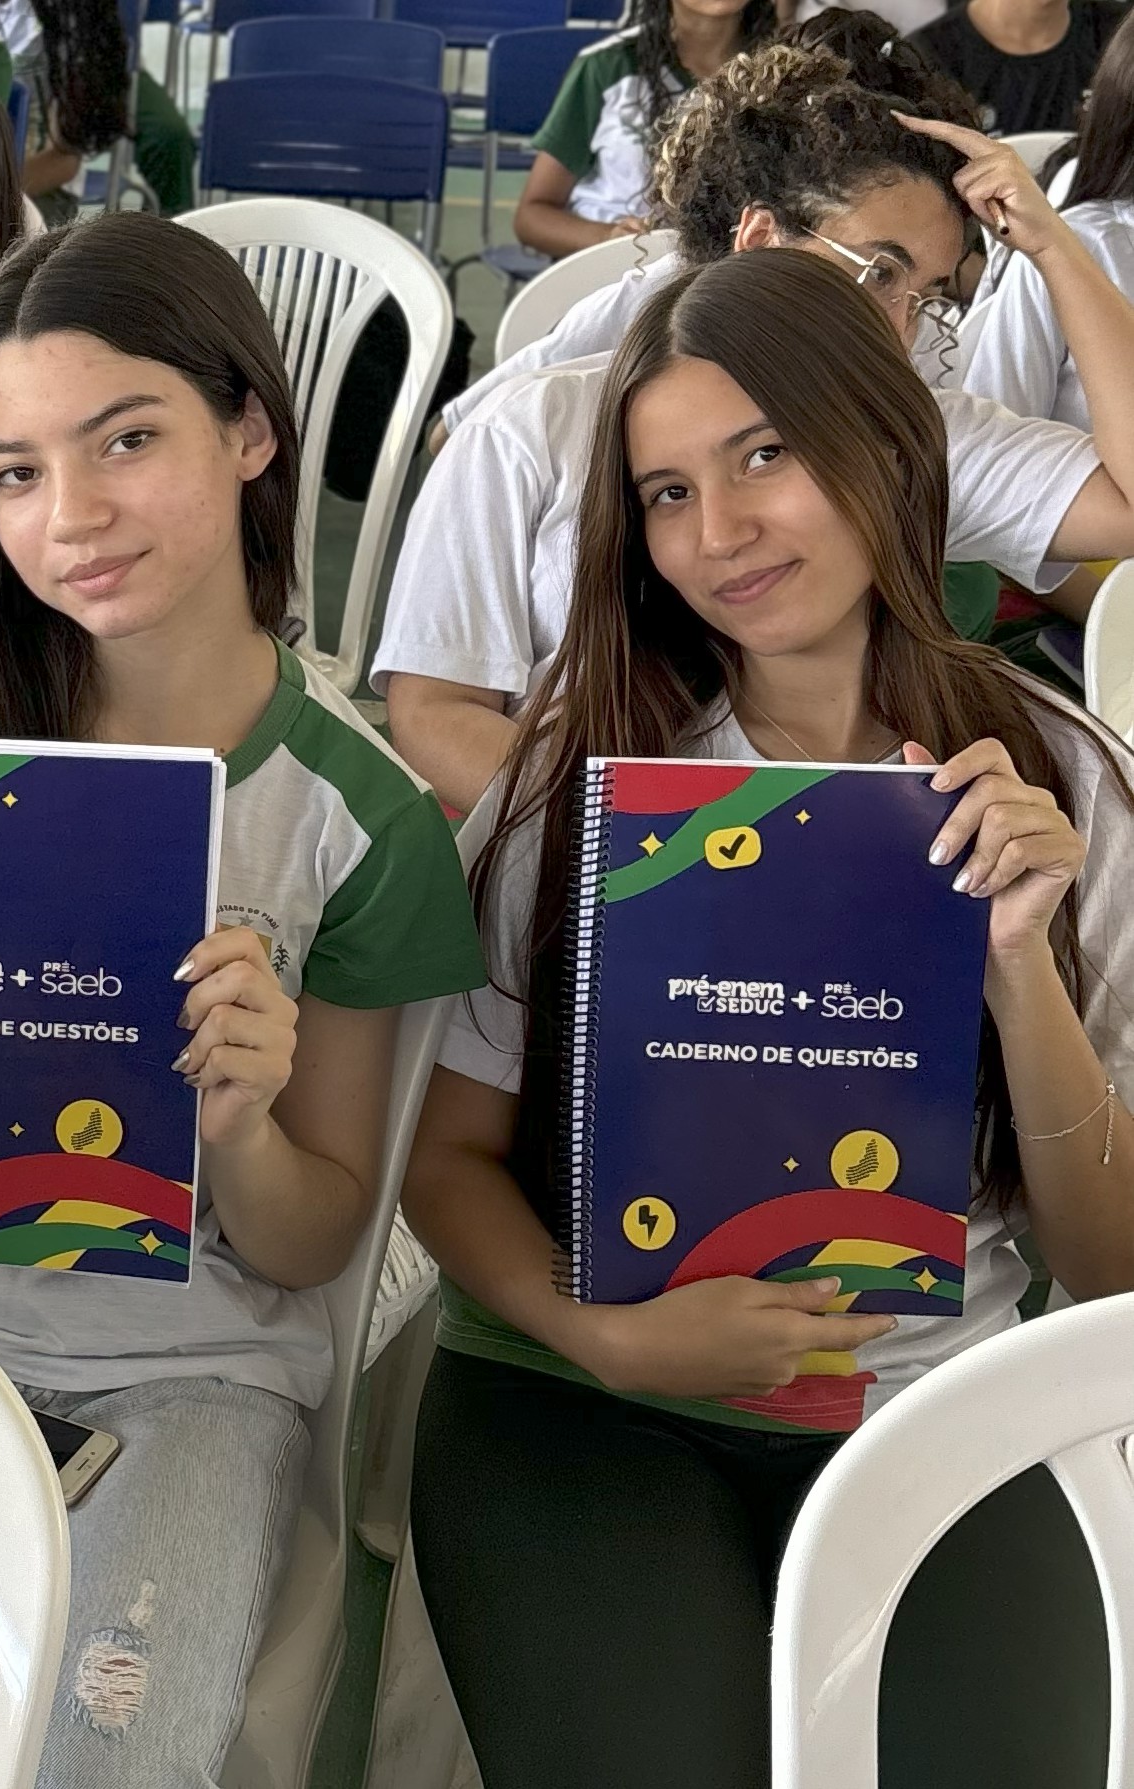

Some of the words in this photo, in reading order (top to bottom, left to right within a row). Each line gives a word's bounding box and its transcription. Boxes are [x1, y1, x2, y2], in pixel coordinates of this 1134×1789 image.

[247, 907, 260, 915] DO
[40, 967, 122, 997] saeb
[668, 974, 785, 1000] pré-enem
[715, 998, 785, 1015] SEDUC
[820, 989, 904, 1020] saeb
[19, 1021, 139, 1042] QUESTÕES
[645, 1041, 758, 1062] CADERNO
[762, 1046, 793, 1064] DE
[797, 1047, 919, 1069] QUESTÕES
